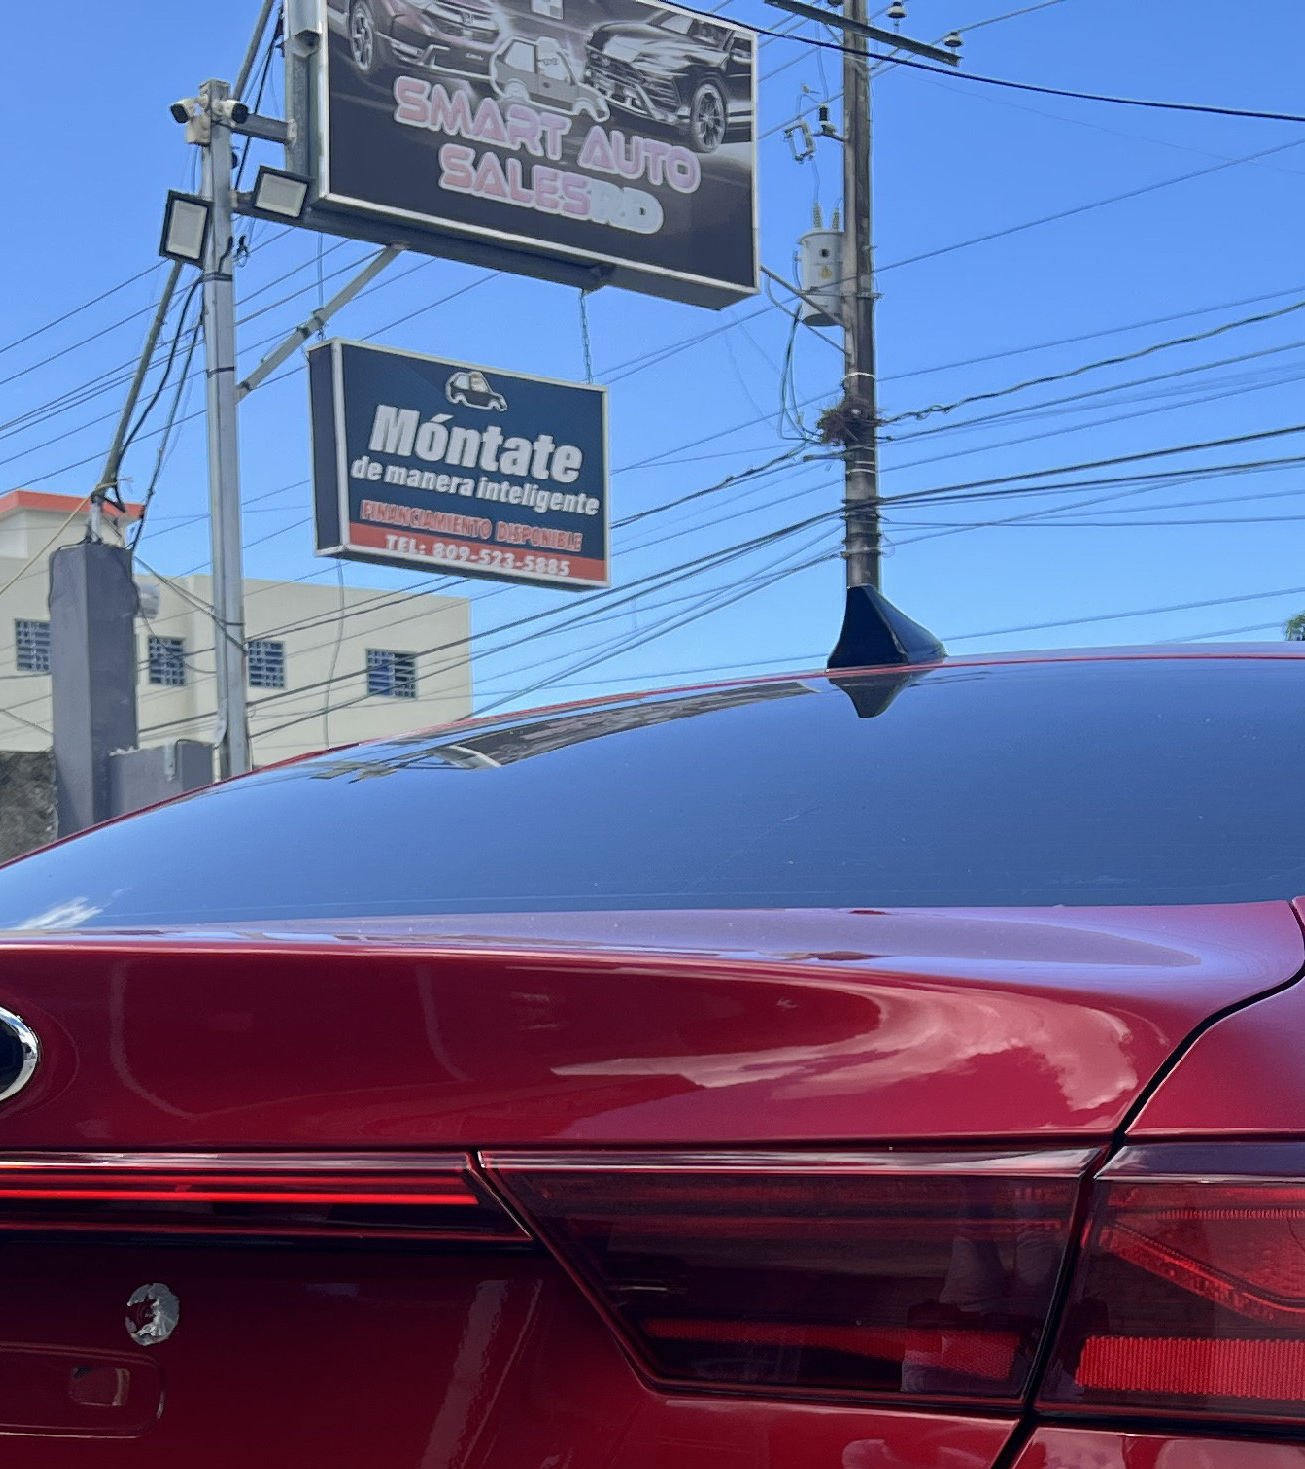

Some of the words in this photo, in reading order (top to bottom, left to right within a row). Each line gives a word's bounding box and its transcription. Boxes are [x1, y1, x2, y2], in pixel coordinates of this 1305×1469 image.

[395, 75, 571, 161] SMART
[578, 126, 701, 193] AUTO
[368, 404, 582, 483] Móntate
[351, 455, 382, 480] de
[384, 463, 475, 497] manera
[477, 477, 600, 515] inteligente
[361, 499, 492, 539] FINANCIAMIENTO
[496, 521, 583, 551] DISPONIBLE
[385, 534, 426, 556] TEL:
[432, 542, 571, 576] 809-523-5885
